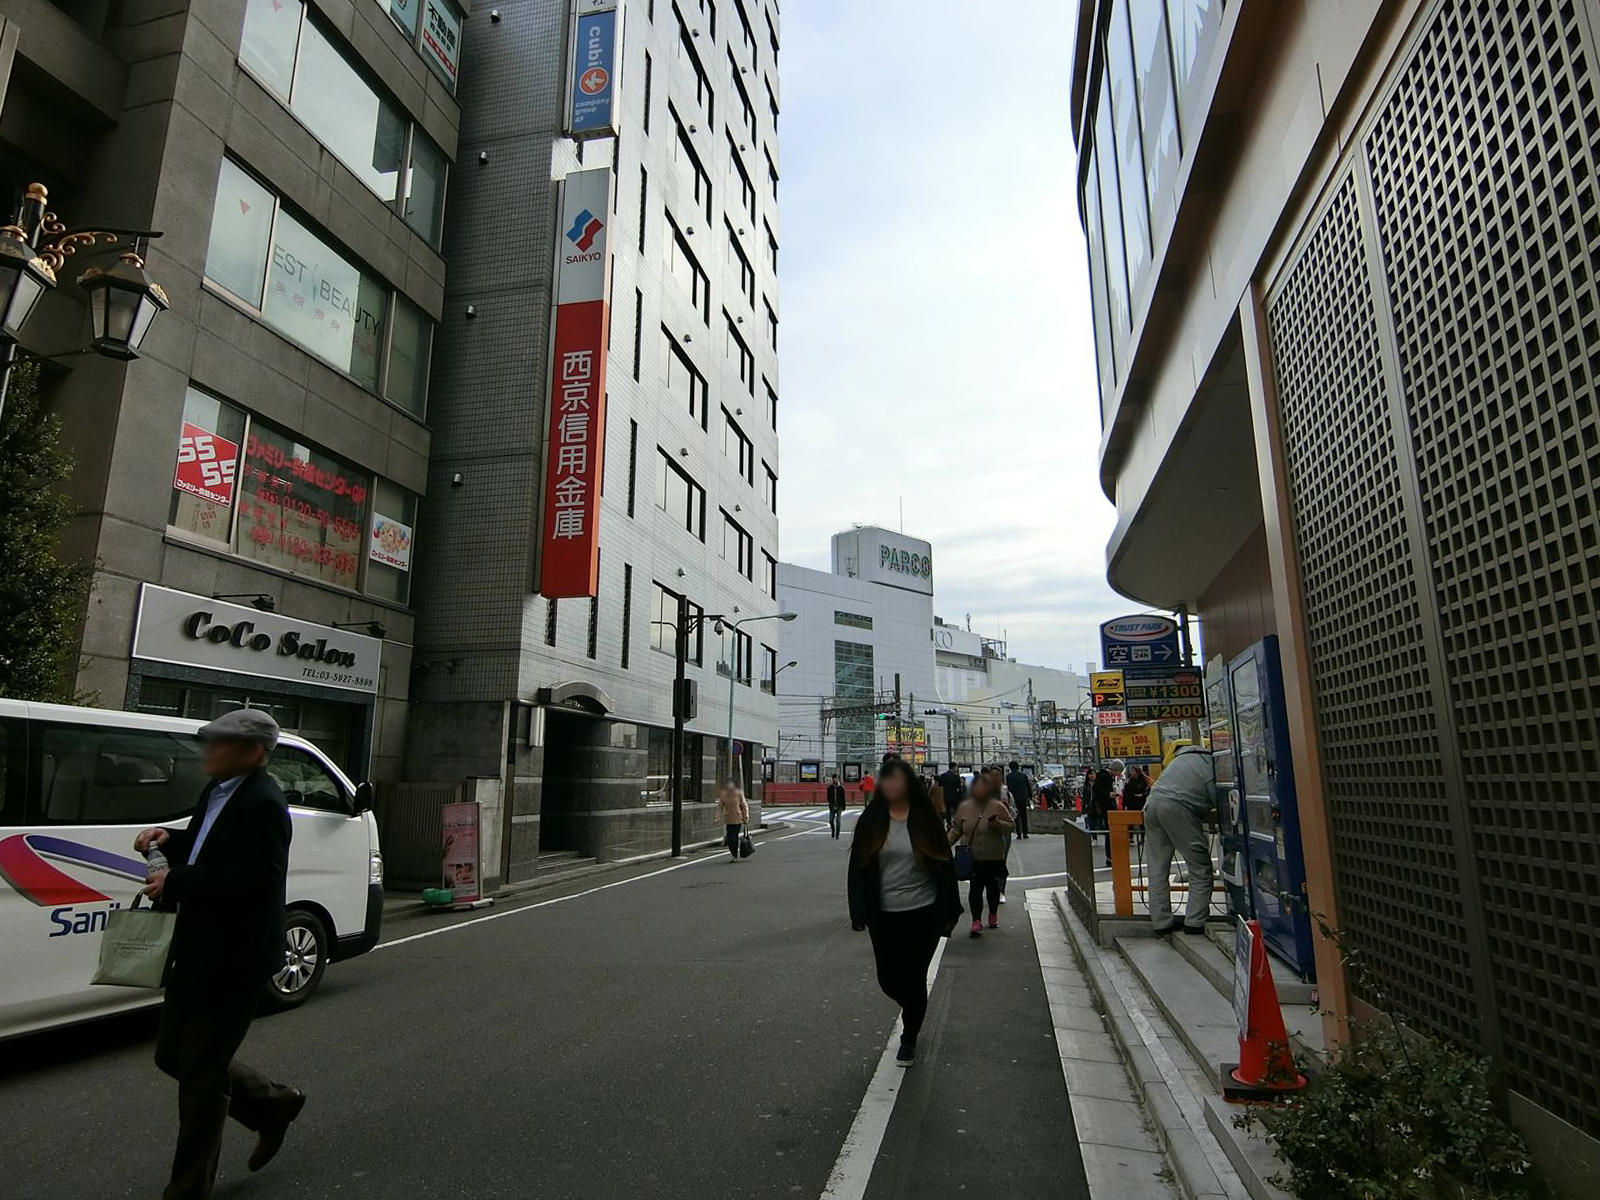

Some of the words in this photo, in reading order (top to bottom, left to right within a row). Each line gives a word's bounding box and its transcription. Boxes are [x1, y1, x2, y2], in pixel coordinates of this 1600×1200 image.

[428, 1, 456, 49] 不動産
[575, 98, 609, 108] company
[575, 106, 597, 116] group
[566, 251, 602, 265] SAIKYO
[273, 243, 308, 282] EST
[320, 279, 380, 336] BEAUTY
[552, 349, 593, 540] 西京信用金庫
[880, 544, 931, 579] PARCO
[1114, 623, 1140, 632] TRUST
[1140, 622, 1163, 631] PARK
[184, 611, 271, 651] CoCo
[278, 630, 357, 668] Salon
[935, 630, 953, 649] CO
[1108, 645, 1129, 664] 空
[1149, 685, 1200, 698] ¥1300
[1095, 694, 1104, 706] P
[1151, 705, 1203, 718] ¥2000
